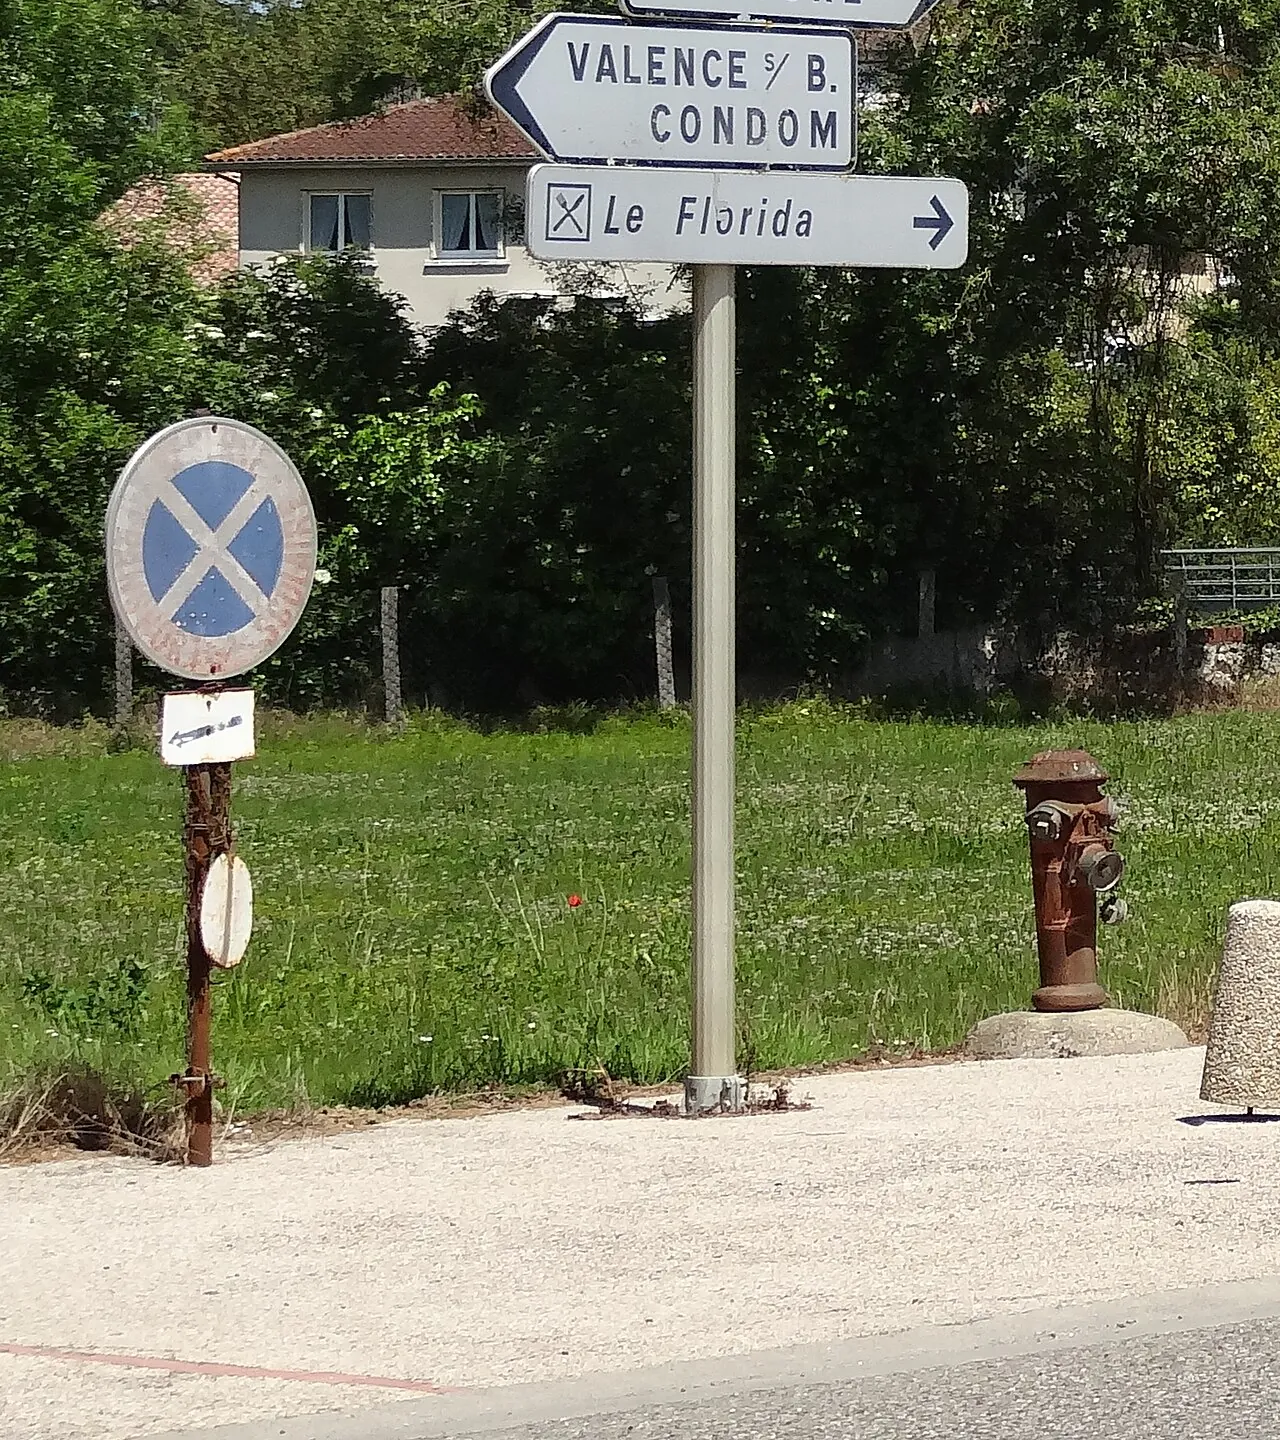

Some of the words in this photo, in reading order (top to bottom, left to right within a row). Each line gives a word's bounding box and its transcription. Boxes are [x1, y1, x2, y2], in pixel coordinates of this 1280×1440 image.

[566, 42, 747, 90] VALENCE
[650, 104, 838, 150] CONDOM
[603, 195, 644, 234] Le
[676, 196, 813, 238] Florida
